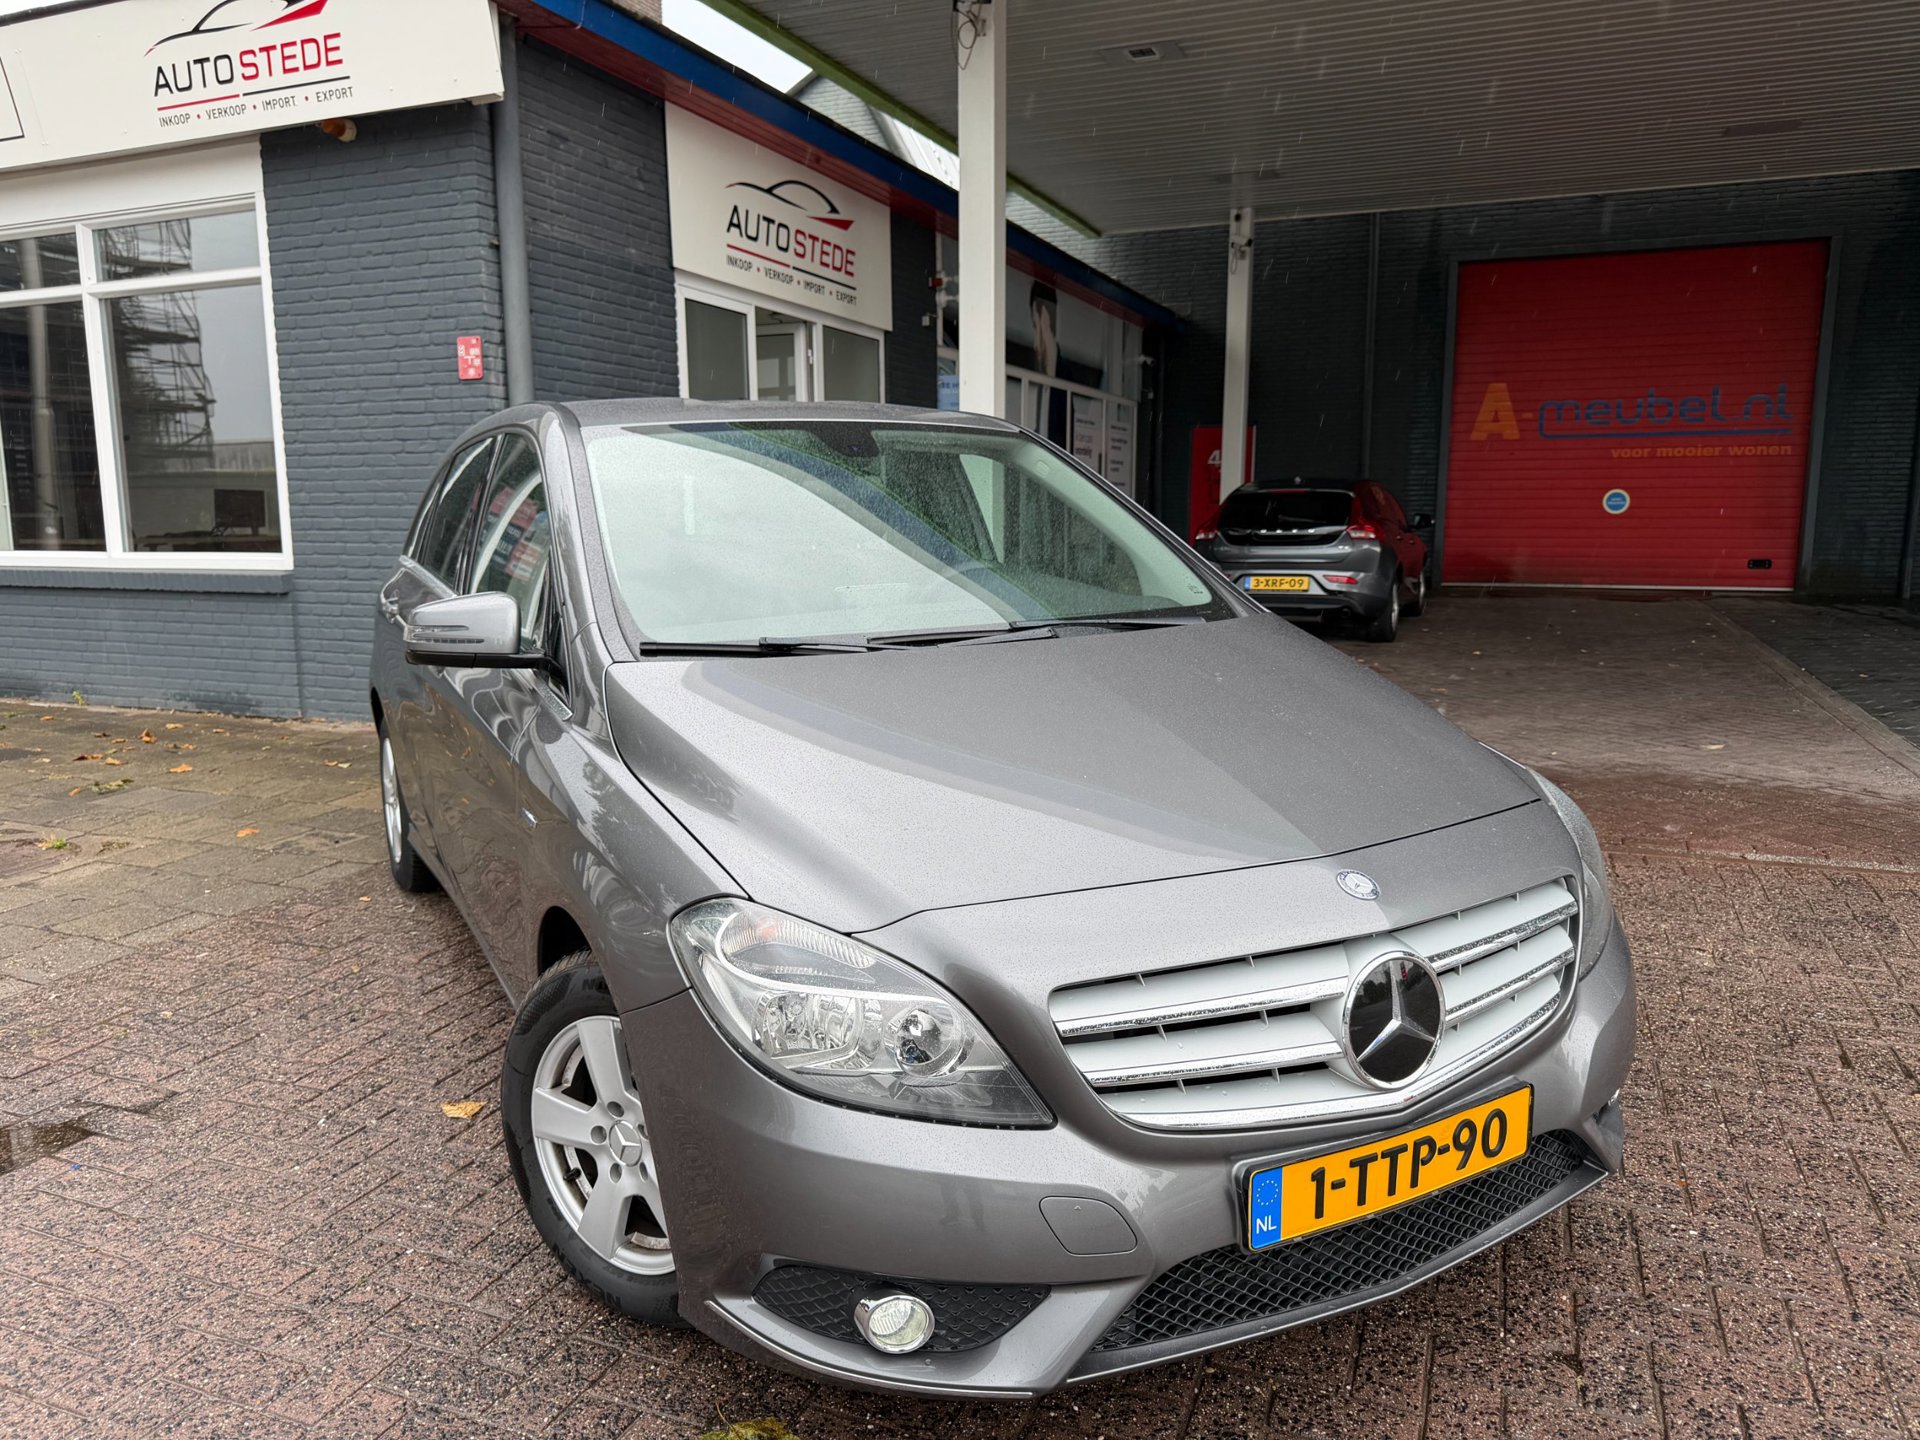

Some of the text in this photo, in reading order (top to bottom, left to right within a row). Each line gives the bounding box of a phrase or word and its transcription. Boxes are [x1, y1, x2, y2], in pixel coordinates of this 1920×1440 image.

[158, 87, 354, 128] INKOOP VERKOOP IMPORT EXPORT
[726, 255, 857, 305] INKOOP VERKOOP IMPORT EXPORT
[1611, 444, 1793, 458] voor mooier wonen
[1253, 578, 1304, 588] 3-XRF-09
[1310, 1108, 1508, 1219] 1-TTP-90
[1255, 1215, 1277, 1234] NL
